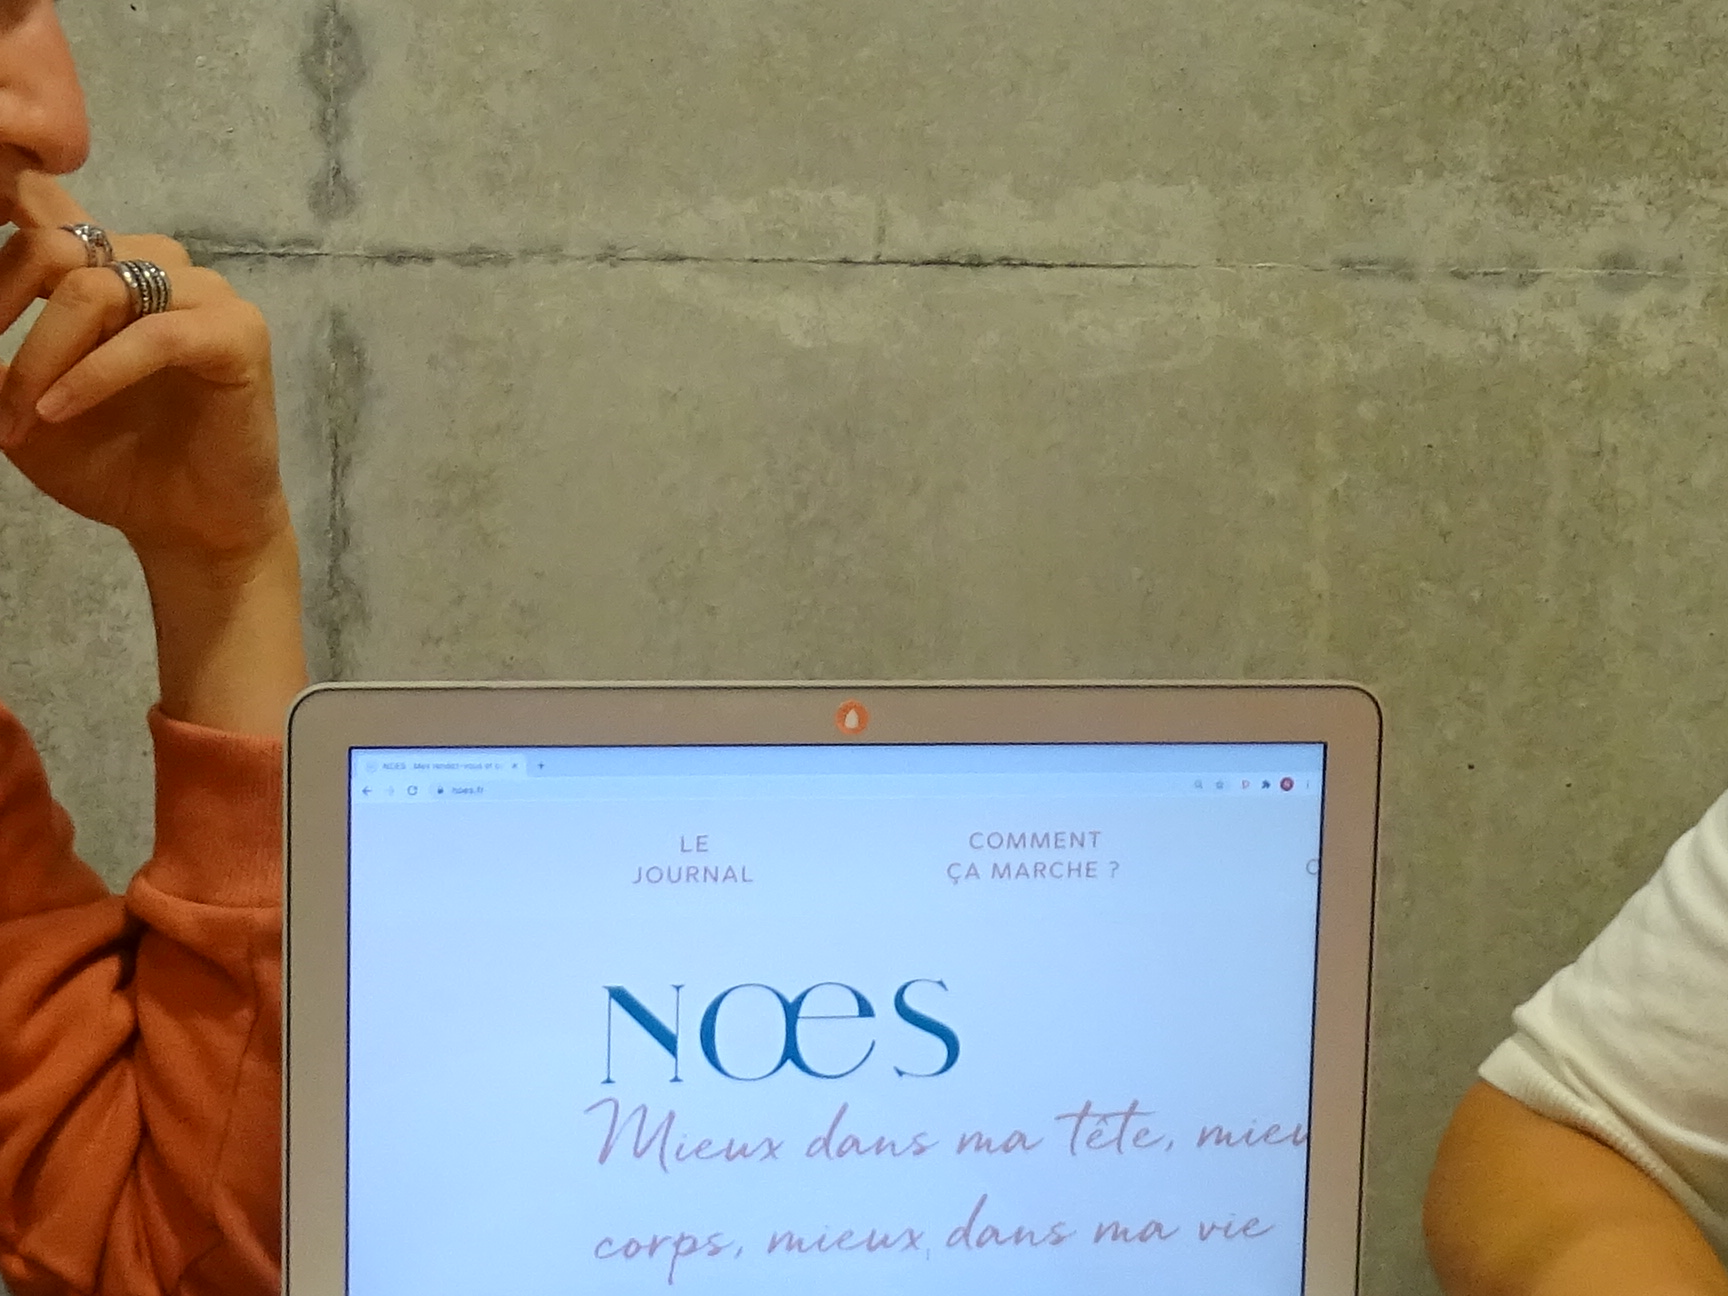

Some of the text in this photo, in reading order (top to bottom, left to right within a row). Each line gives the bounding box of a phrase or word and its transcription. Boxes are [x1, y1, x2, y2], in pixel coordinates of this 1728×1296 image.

[680, 834, 710, 854] LE
[968, 829, 1103, 851] COMMENT
[631, 864, 754, 885] JOURNAL
[946, 861, 982, 886] ÇA
[990, 860, 1099, 881] MARCHE
[583, 1096, 785, 1174] Mieux
[804, 1101, 940, 1161] dans
[955, 1128, 1045, 1156] ma
[1054, 1098, 1174, 1157] tête,
[593, 1231, 745, 1286] corps,
[945, 1192, 1078, 1251] dans
[1092, 1218, 1181, 1245] ma
[1197, 1213, 1277, 1243] vie
